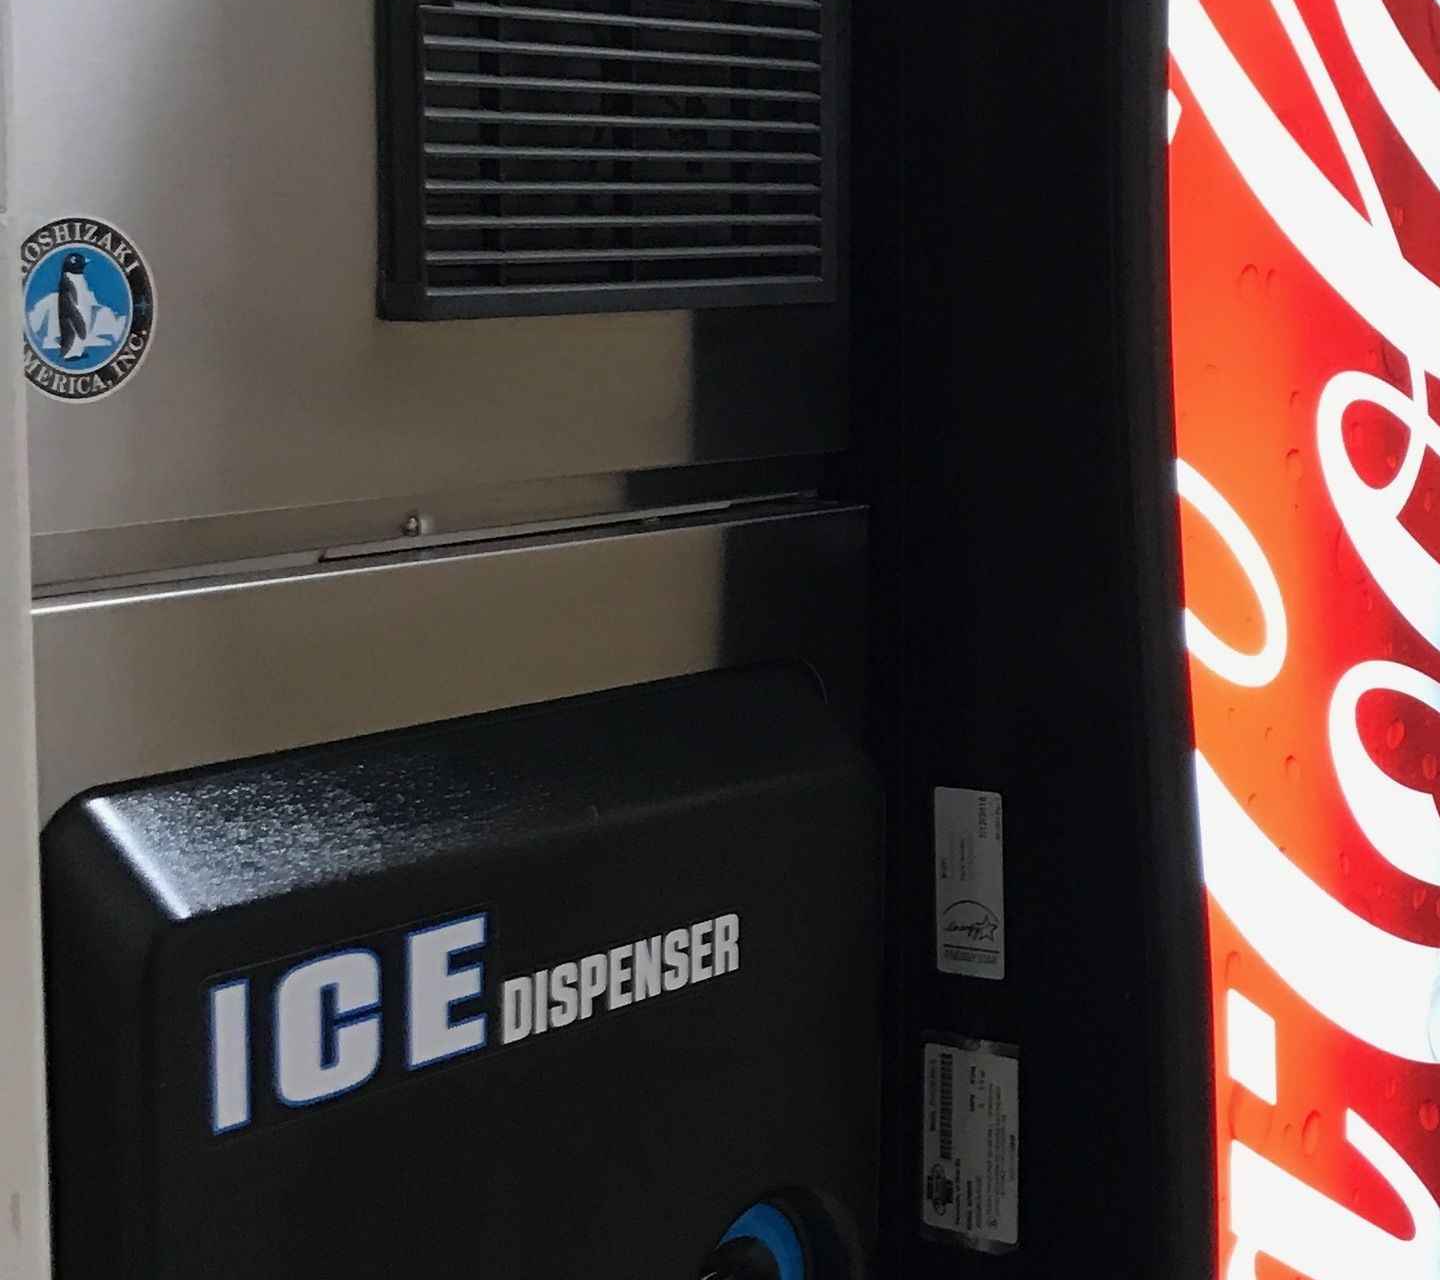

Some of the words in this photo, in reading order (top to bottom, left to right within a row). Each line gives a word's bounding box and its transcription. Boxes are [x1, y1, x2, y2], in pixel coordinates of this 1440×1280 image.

[24, 344, 114, 395] MERICA,
[111, 329, 147, 377] INC.
[209, 912, 488, 1135] ICE
[502, 912, 740, 1045] DISPENSER
